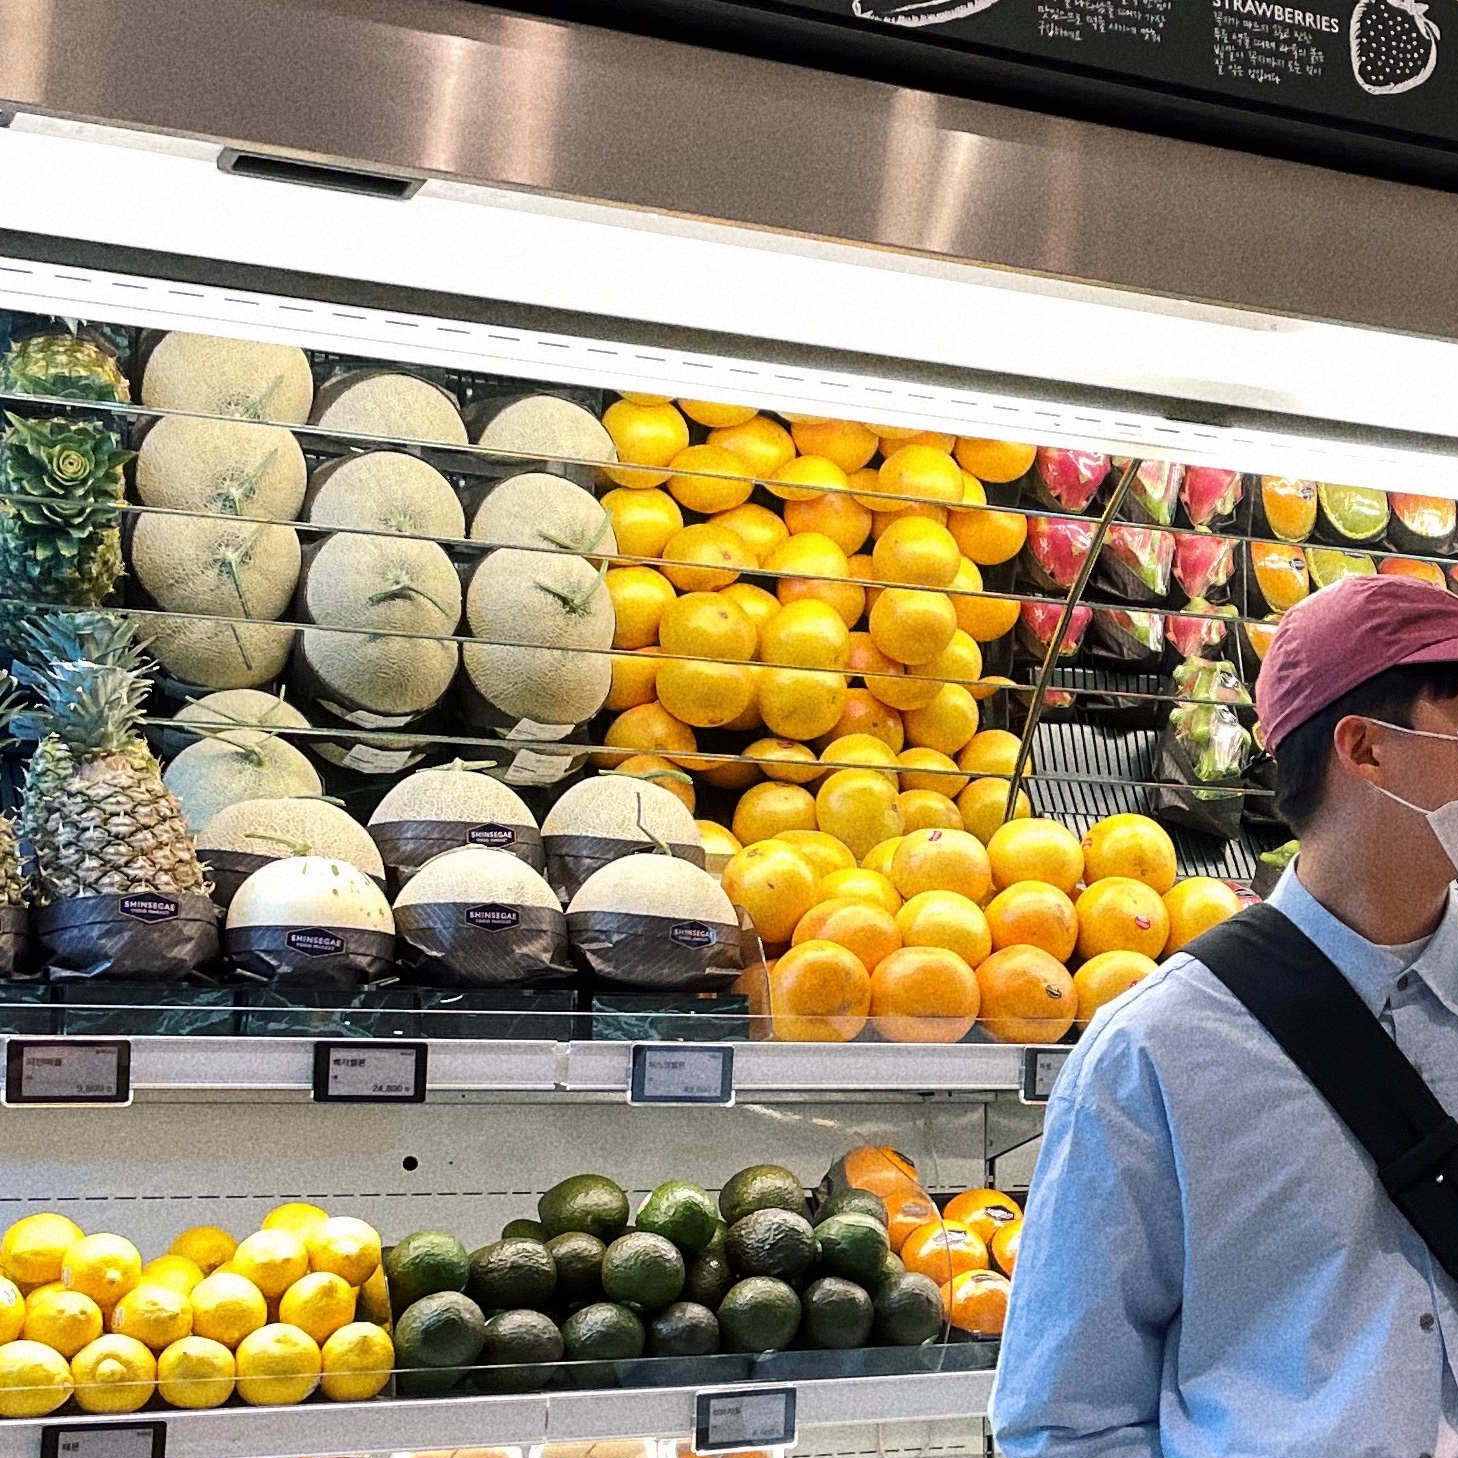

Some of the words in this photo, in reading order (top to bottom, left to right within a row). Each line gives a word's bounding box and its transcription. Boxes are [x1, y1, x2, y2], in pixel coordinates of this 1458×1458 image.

[471, 830, 512, 839] SHINSEGAE
[124, 900, 176, 912] SHINSEGAE
[469, 911, 517, 920] SHINSEGAE
[290, 935, 342, 948] SHINSEGAE
